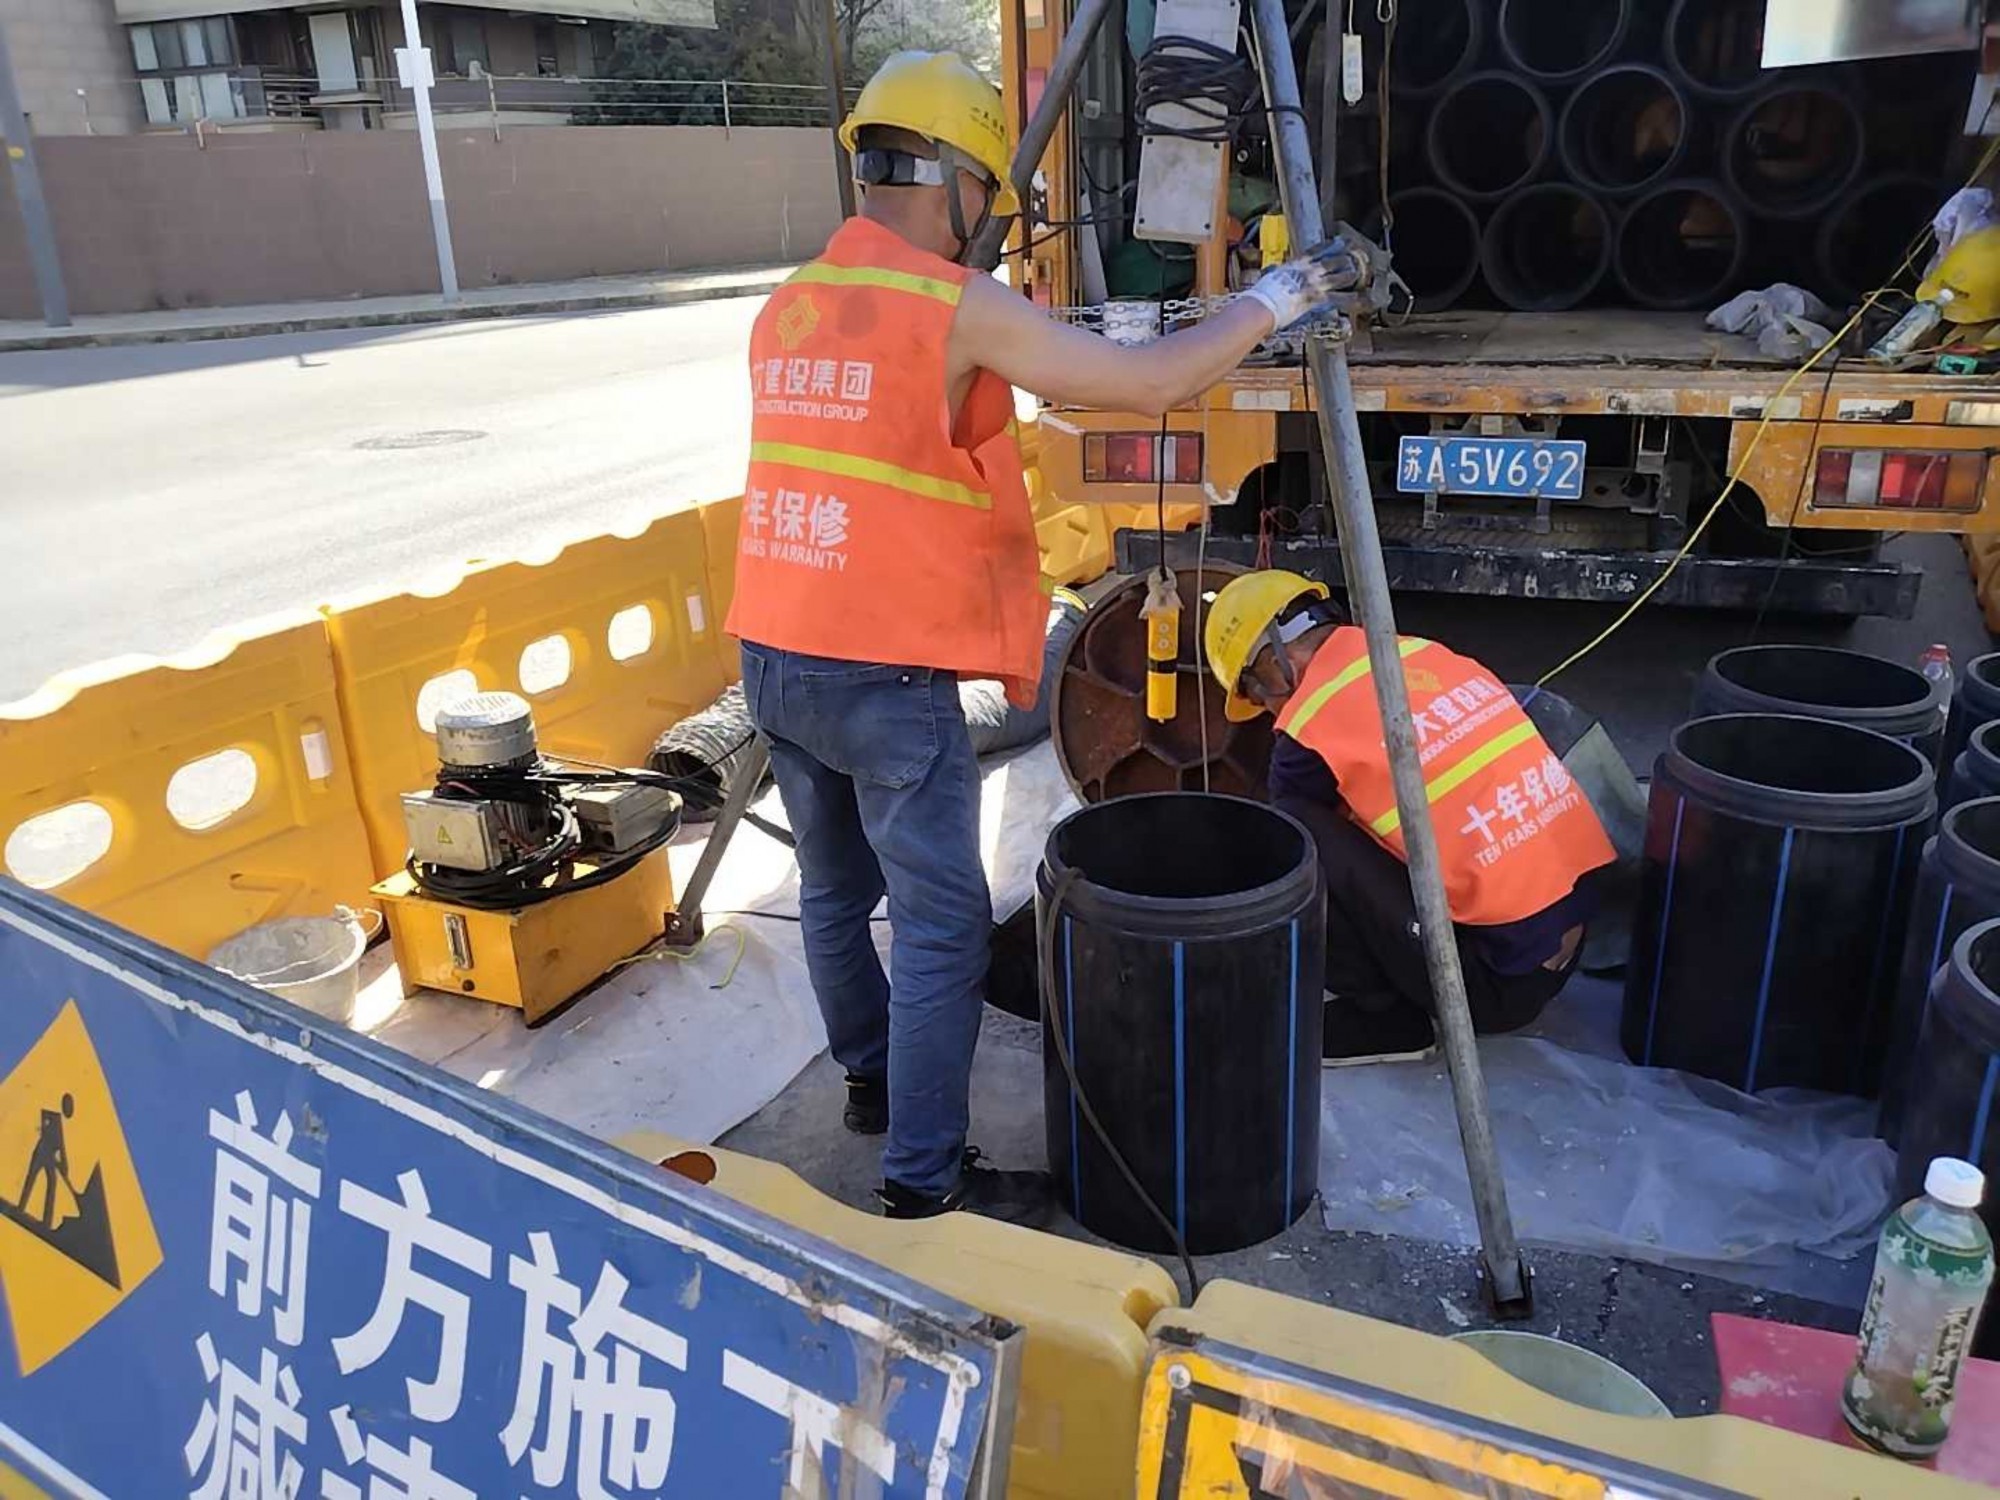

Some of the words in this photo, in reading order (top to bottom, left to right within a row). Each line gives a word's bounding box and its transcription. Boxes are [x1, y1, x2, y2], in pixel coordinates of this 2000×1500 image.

[823, 404, 869, 421] GROUP
[770, 540, 848, 572] WARRANTY
[1460, 754, 1571, 844] 十年保修
[1475, 843, 1502, 868] TEN
[1502, 819, 1539, 852] YEARS
